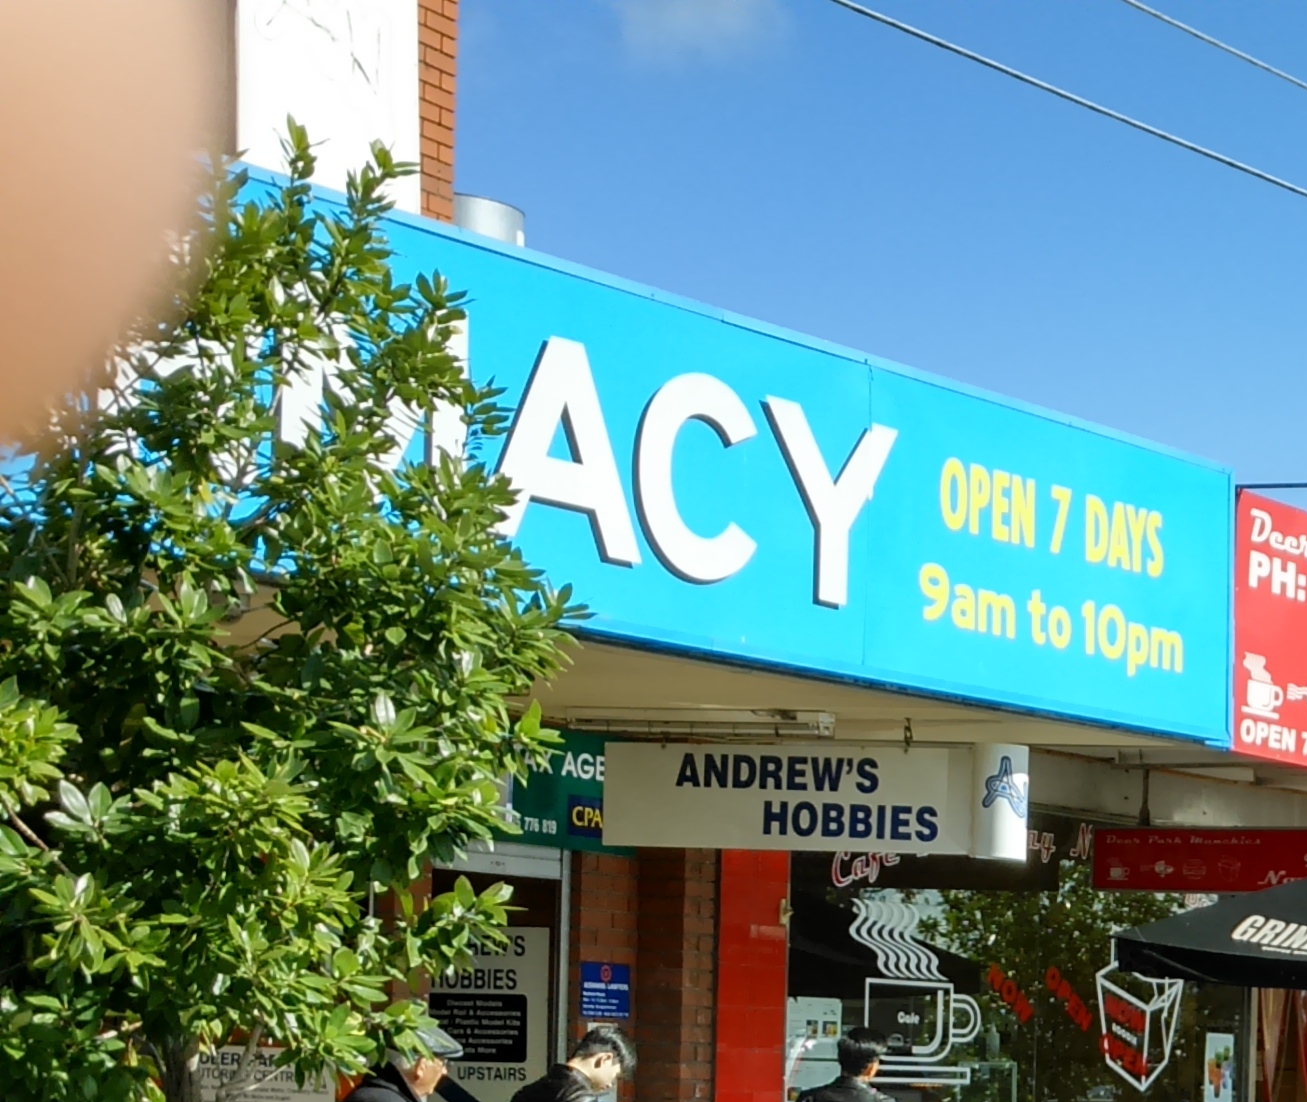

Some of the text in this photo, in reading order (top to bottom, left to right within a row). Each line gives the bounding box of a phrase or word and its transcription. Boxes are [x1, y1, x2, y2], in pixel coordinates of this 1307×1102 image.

[941, 457, 1164, 577] OPEN 7 DAYS
[1248, 551, 1307, 603] PH:
[919, 563, 1183, 677] 9am to 10pm
[1240, 718, 1297, 753] OPEN
[675, 752, 880, 794] ANDREW'S
[763, 801, 939, 842] HOBBIES
[431, 969, 517, 990] HOBBIES
[457, 1066, 527, 1081] UPSTAIRS
